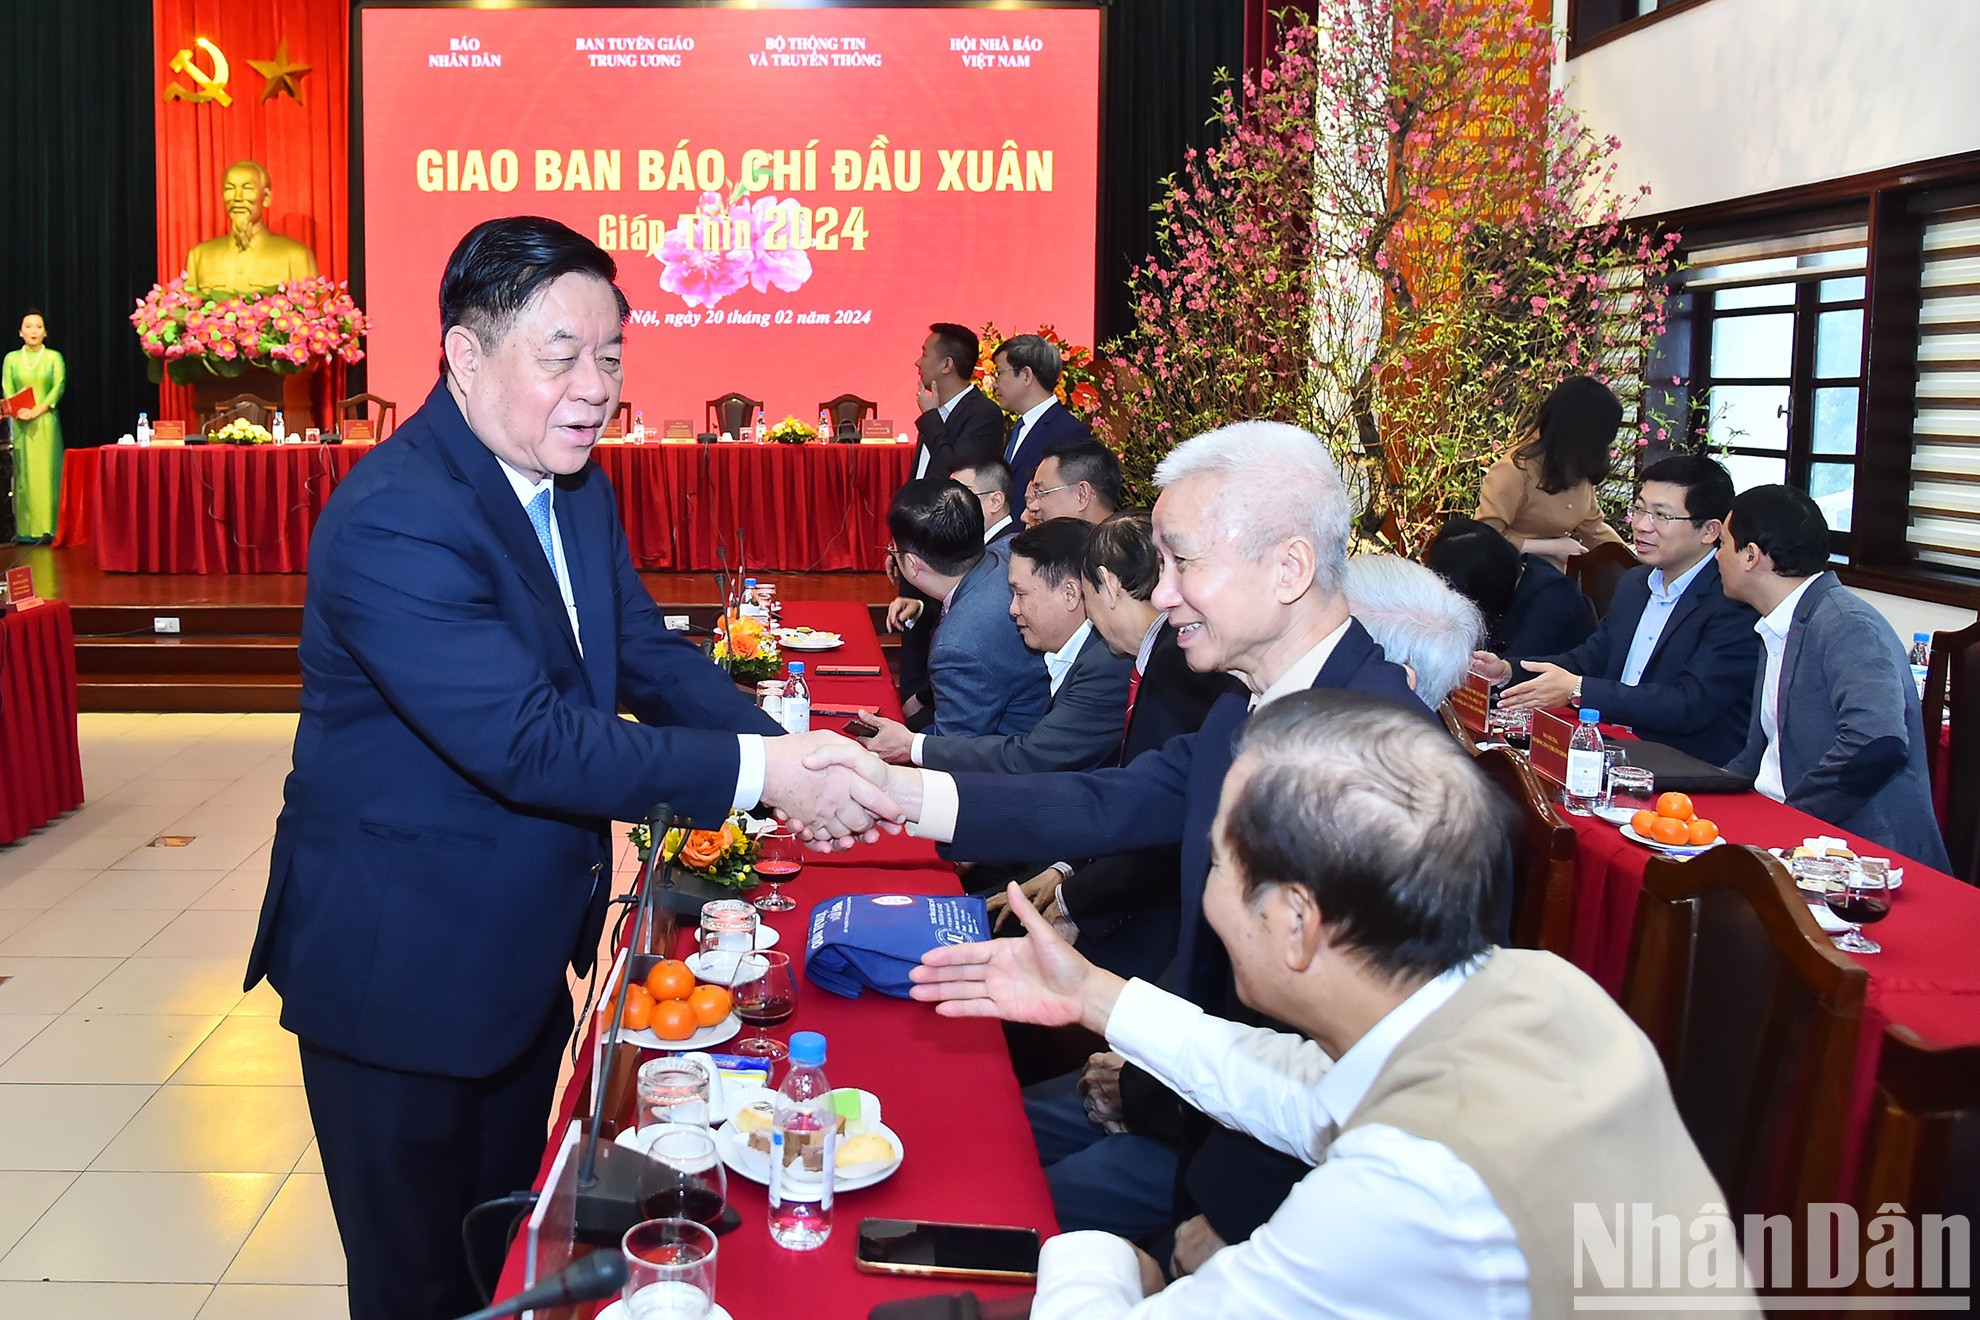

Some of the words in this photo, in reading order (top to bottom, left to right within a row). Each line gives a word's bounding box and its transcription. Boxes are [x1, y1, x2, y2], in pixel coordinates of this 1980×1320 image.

[449, 35, 480, 51] BÁO
[575, 37, 604, 51] BAN
[607, 35, 655, 51] TUYÊN
[657, 35, 695, 51] GIÁO
[765, 35, 786, 53] BỘ
[788, 35, 839, 51] THÔNG
[841, 37, 866, 51] TIN
[950, 35, 977, 53] HỘI
[979, 36, 1010, 51] NHÀ
[1012, 35, 1043, 51] BÁO
[428, 52, 470, 67] NHÂN
[471, 52, 501, 67] DÂN
[588, 53, 639, 67] TRUNG
[749, 52, 769, 67] VÀ
[830, 52, 882, 67] THÔNG
[961, 52, 996, 69] VIỆT
[997, 54, 1031, 67] NAM
[416, 149, 519, 192] GIAO
[535, 149, 621, 191] BAN
[638, 139, 725, 192] BÁO
[741, 139, 820, 192] CHÍ
[831, 134, 921, 192] ĐẦU
[937, 139, 1053, 192] XUÂN
[598, 213, 666, 258] Giáp
[678, 213, 752, 254] Thìn
[764, 206, 870, 251] 2024
[630, 310, 661, 327] Nội,
[665, 311, 702, 327] ngày
[704, 309, 725, 324] 20
[727, 309, 772, 327] tháng
[774, 309, 794, 324] 02
[797, 310, 831, 324] năm
[833, 309, 872, 324] 2024
